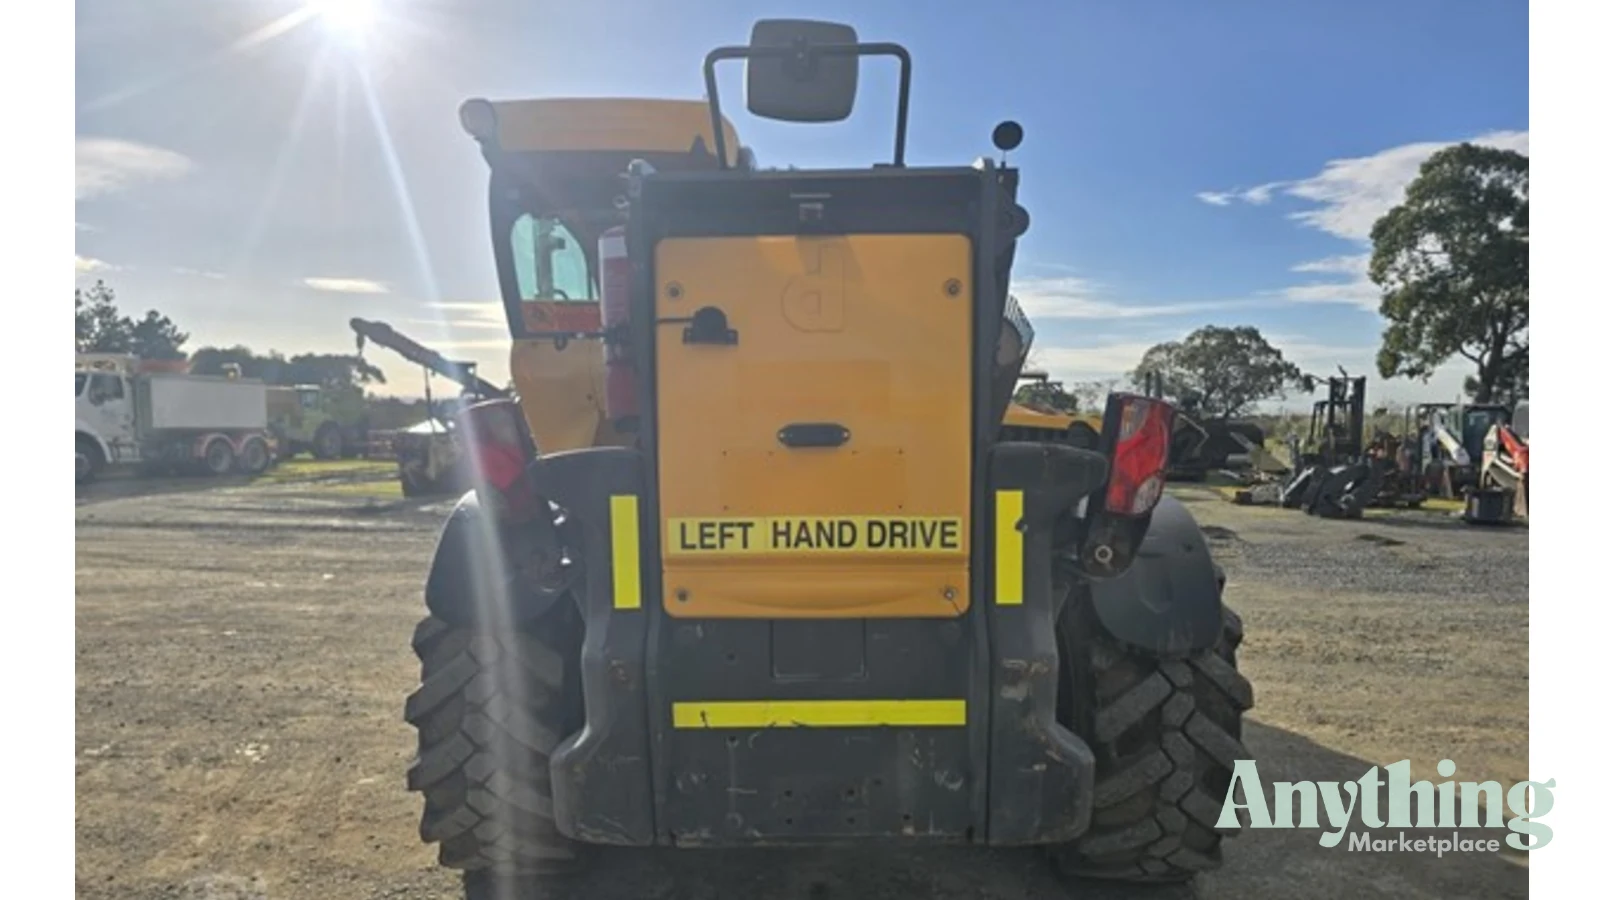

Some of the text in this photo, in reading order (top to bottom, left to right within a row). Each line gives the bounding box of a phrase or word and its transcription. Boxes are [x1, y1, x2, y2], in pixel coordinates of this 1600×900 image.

[679, 520, 959, 550] LEFT HAND DRIVE
